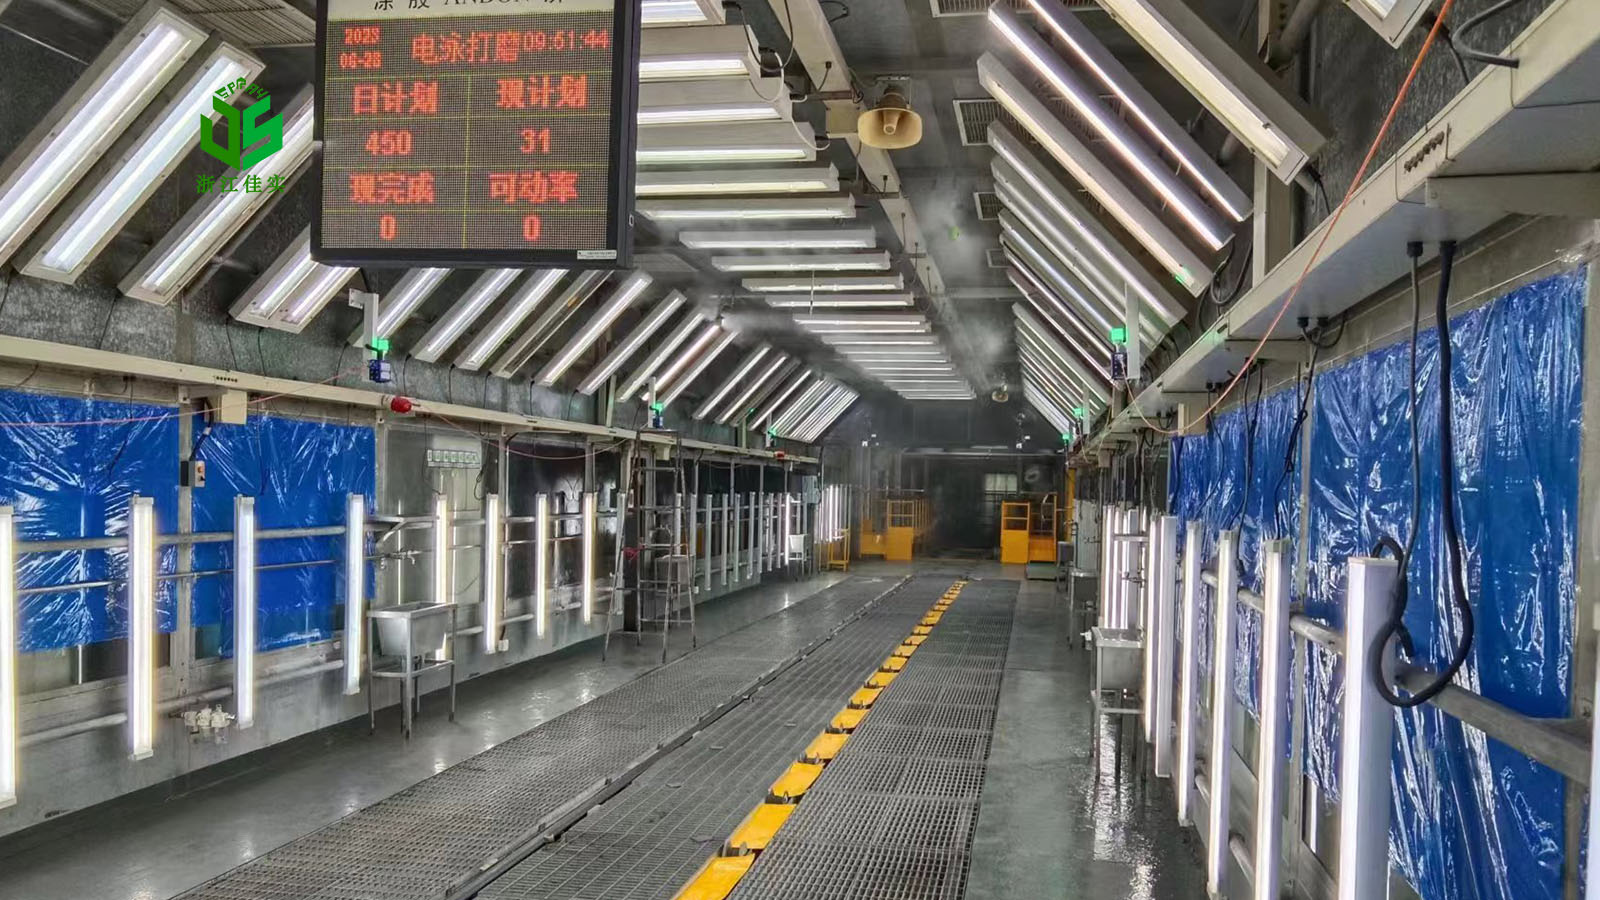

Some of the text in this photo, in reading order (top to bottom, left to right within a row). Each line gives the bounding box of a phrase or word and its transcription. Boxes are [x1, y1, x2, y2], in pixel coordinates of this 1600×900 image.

[411, 30, 520, 64] 电泳打磨
[353, 81, 439, 115] 日计划
[497, 74, 588, 109] 现计划
[365, 128, 413, 155] 450
[520, 127, 552, 153] 31
[350, 171, 436, 205] 现完成
[488, 170, 580, 204] 可动率
[378, 215, 398, 241] 0
[522, 214, 543, 242] 0
